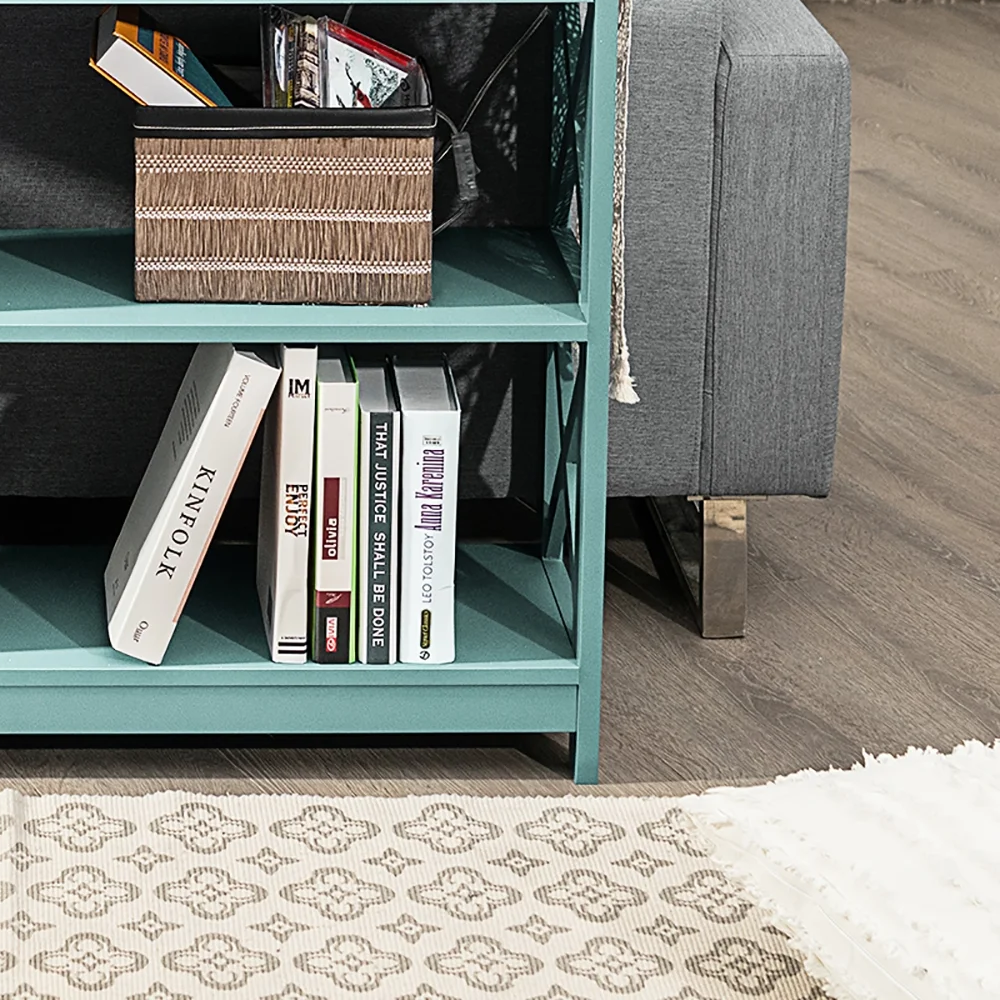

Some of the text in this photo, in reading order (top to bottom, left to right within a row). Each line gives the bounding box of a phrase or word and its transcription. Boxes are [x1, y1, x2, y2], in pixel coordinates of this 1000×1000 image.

[288, 378, 310, 397] IM
[415, 448, 445, 500] Karenina
[155, 464, 217, 581] KINFOLK
[284, 484, 300, 539] ENJOY
[297, 484, 309, 538] PERFECT
[324, 518, 338, 557] olivia
[372, 422, 388, 647] THAT JUSTICE SHALL BE DONE
[414, 503, 443, 532] Anna
[421, 533, 435, 604] LEO TOLSTOY
